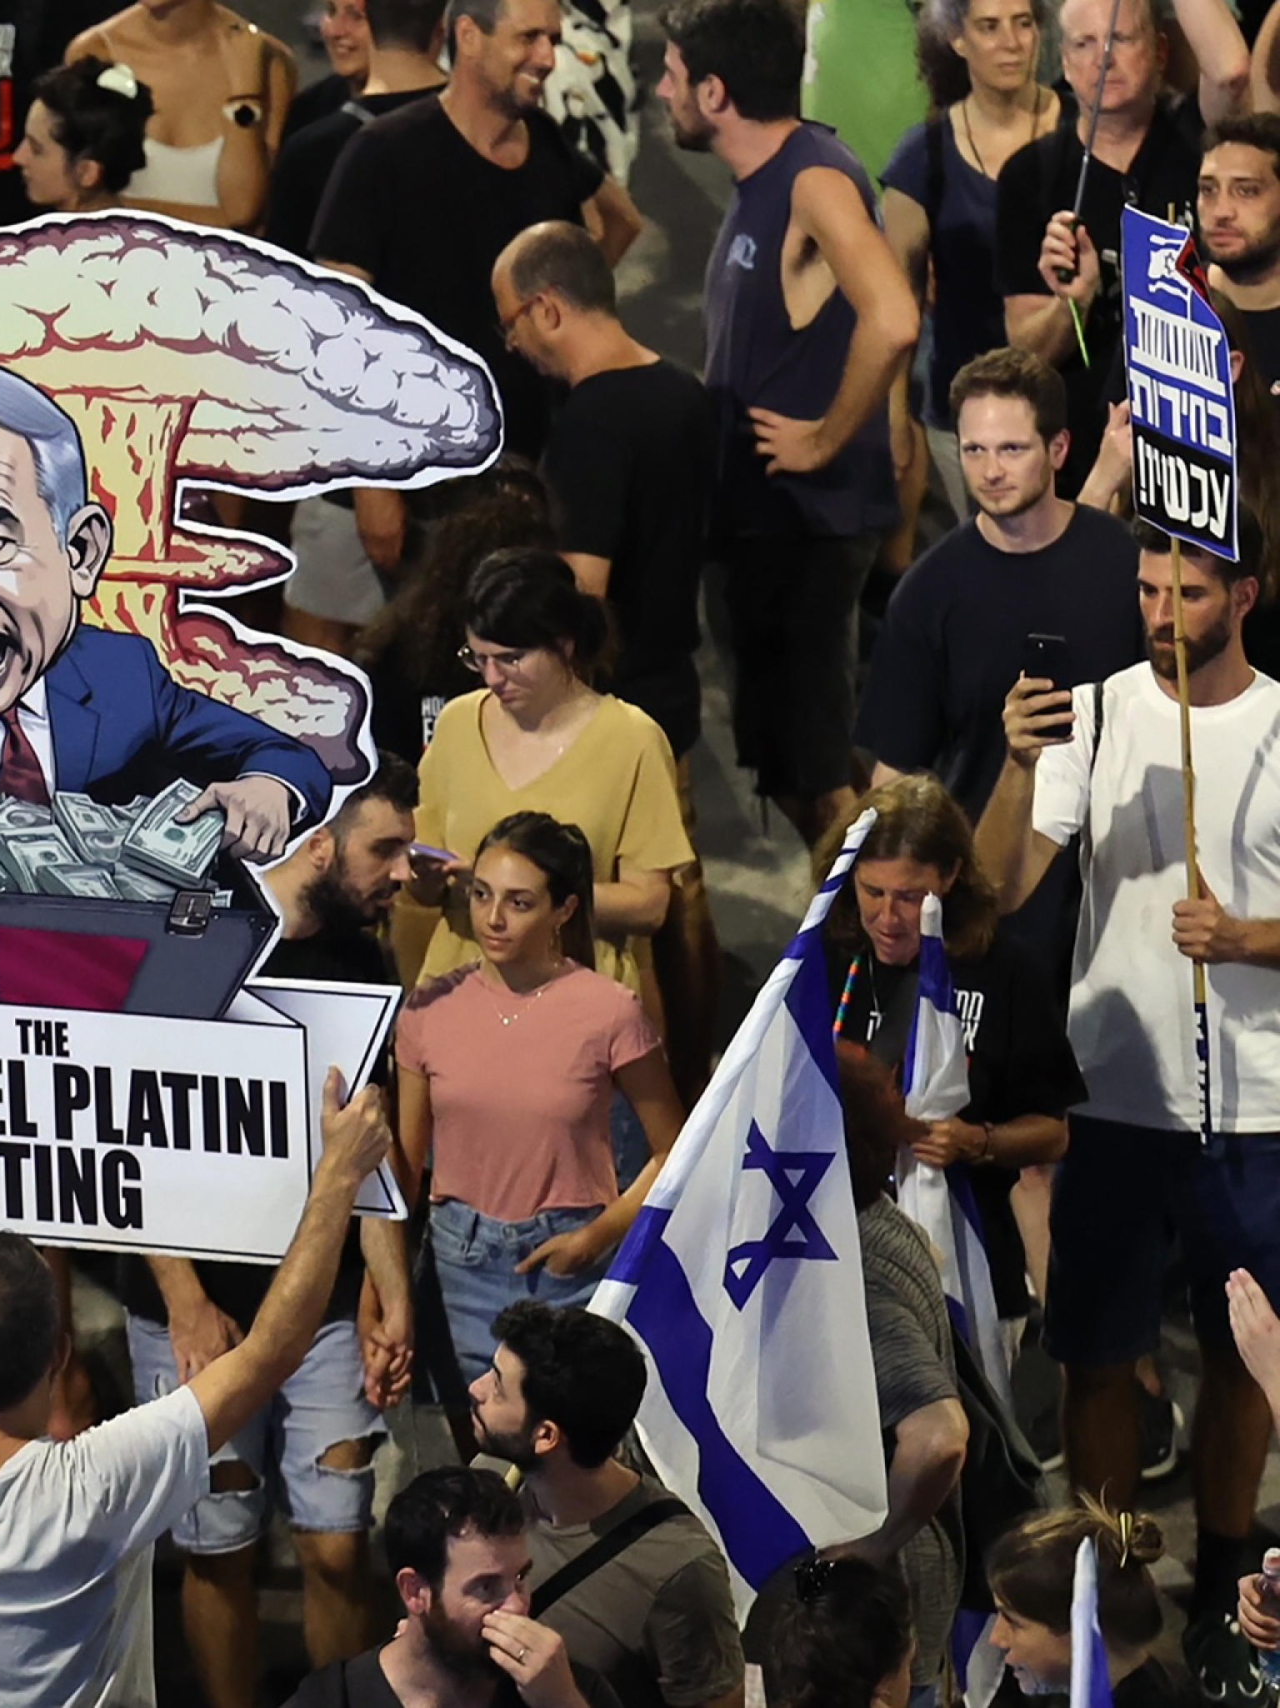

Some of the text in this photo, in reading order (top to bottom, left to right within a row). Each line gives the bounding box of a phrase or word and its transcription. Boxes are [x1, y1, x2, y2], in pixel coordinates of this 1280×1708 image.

[1129, 367, 1231, 457] בחירות
[1137, 436, 1230, 539] עכשיו!
[15, 1018, 70, 1058] THE
[52, 1062, 290, 1159] PLATINI
